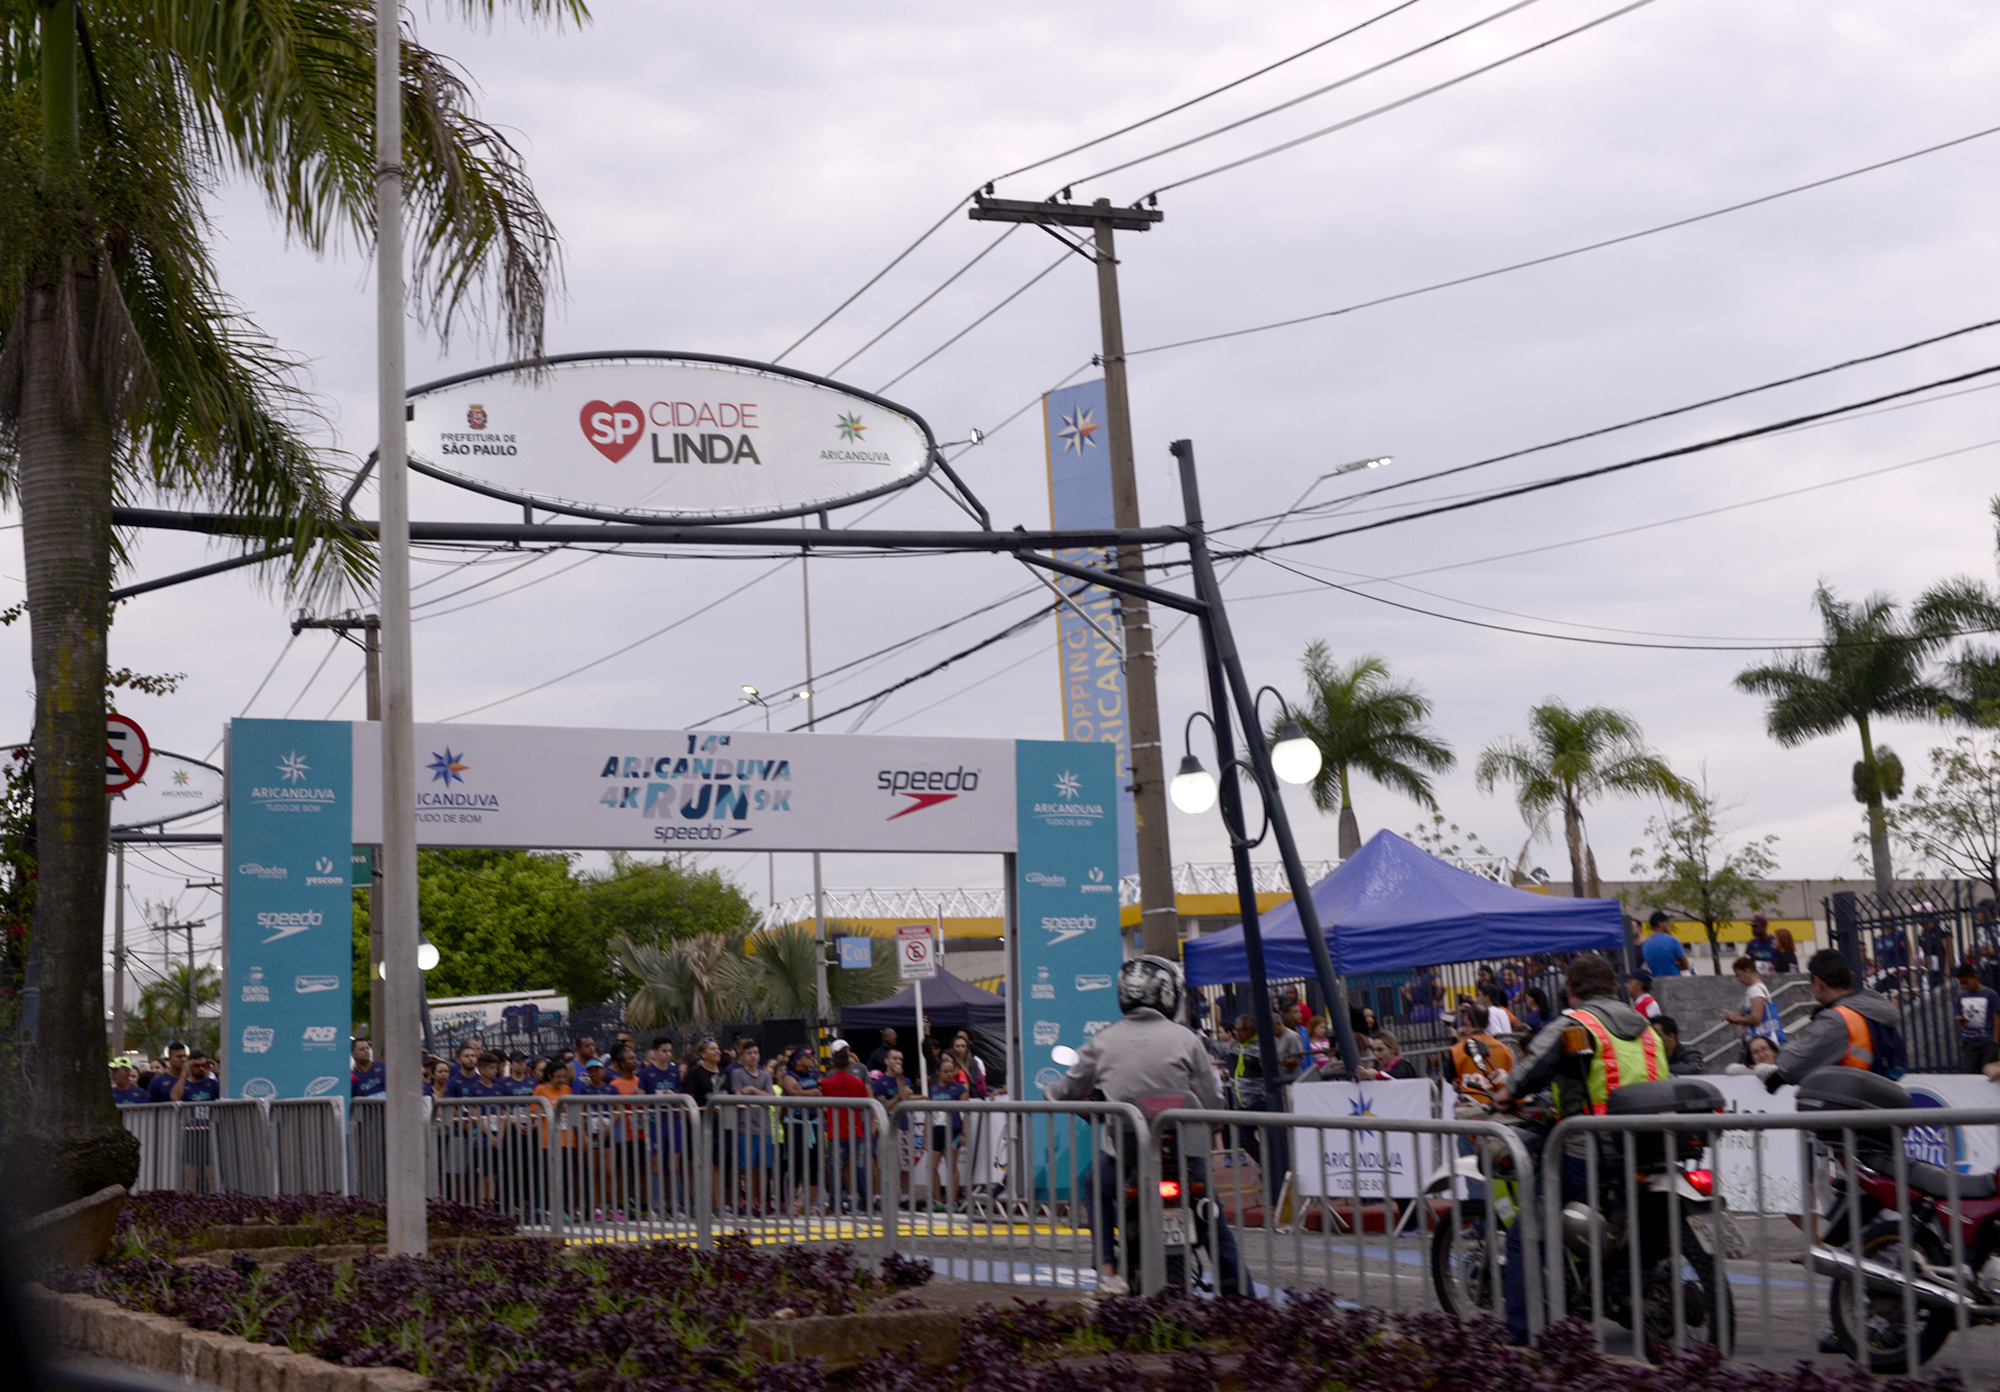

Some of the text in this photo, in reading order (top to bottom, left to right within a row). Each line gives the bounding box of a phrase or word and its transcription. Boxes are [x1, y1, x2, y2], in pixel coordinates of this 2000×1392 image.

[650, 401, 759, 428] CIDADE
[591, 412, 639, 444] SP
[441, 432, 517, 443] PREFEITURA DE
[442, 442, 517, 456] SÃO PAULO
[651, 432, 761, 465] LINDA
[820, 449, 891, 462] ARICANDUVA
[1066, 627, 1094, 742] OPPING
[600, 756, 791, 782] ARICANDUVA
[877, 765, 979, 796] speedo
[251, 787, 335, 799] ARICANDUVA
[417, 792, 500, 806] ICANDUVA
[600, 782, 793, 820] 4K RUN 9K
[266, 803, 322, 813] TUDO DE BOM
[1033, 803, 1104, 814] ARICANDUVA
[443, 814, 457, 823] DE
[459, 814, 482, 824] BOM
[654, 823, 722, 844] speedo
[305, 876, 343, 887] yescom
[257, 909, 323, 929] speedo
[1041, 914, 1097, 932] speedo
[1324, 1152, 1403, 1169] ARICNDUVA
